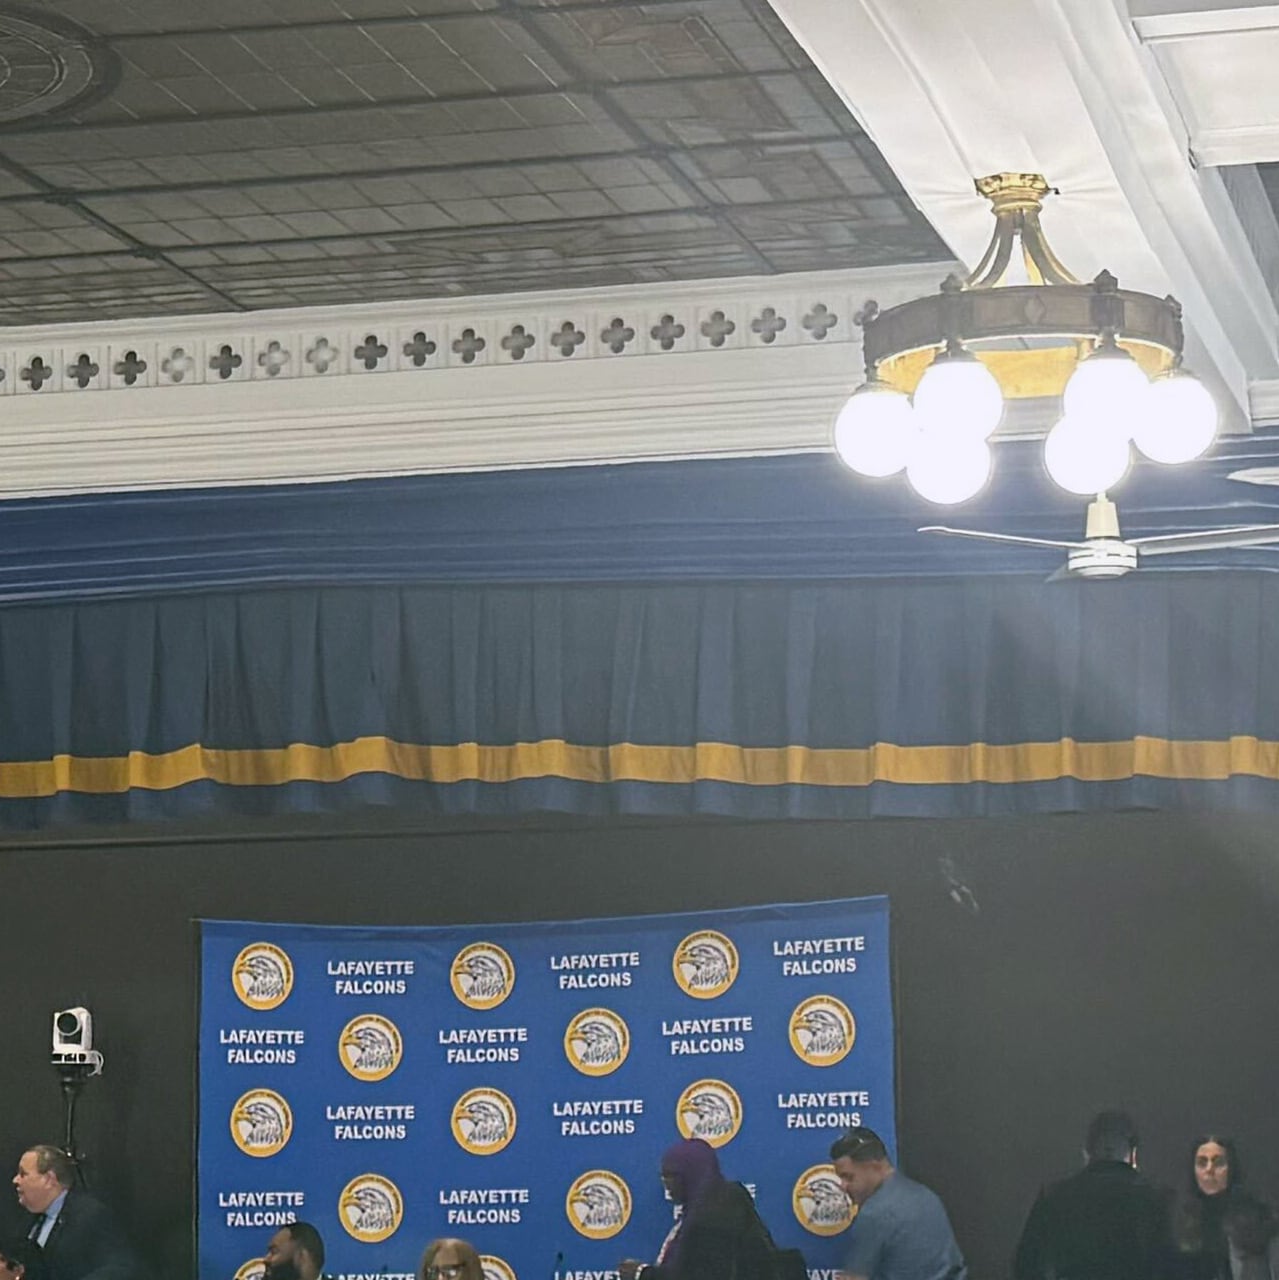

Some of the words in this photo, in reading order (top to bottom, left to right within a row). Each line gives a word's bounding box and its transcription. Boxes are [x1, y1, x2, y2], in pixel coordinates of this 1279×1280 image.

[773, 935, 865, 956] LAFAYETTE
[327, 960, 414, 976] LAFAYETTE
[550, 951, 640, 970] LAFAYETTE
[783, 957, 857, 976] FALCONS
[335, 980, 406, 995] FALCONS
[559, 971, 632, 990] FALCONS
[662, 1016, 753, 1036] LAFAYETTE
[220, 1029, 304, 1044] LAFAYETTE
[439, 1027, 528, 1044] LAFAYETTE
[671, 1037, 745, 1055] FALCONS
[227, 1048, 296, 1064] FALCONS
[447, 1047, 519, 1064] FALCONS
[553, 1099, 643, 1116] LAFAYETTE
[777, 1091, 870, 1108] LAFAYETTE
[326, 1105, 415, 1120] LAFAYETTE
[787, 1112, 861, 1128] FALCONS
[335, 1124, 406, 1140] FALCONS
[561, 1119, 635, 1136] FALCONS
[219, 1192, 304, 1207] LAFAYETTE
[439, 1189, 529, 1205] LAFAYETTE
[227, 1211, 297, 1227] FALCONS
[448, 1209, 521, 1224] FALCONS
